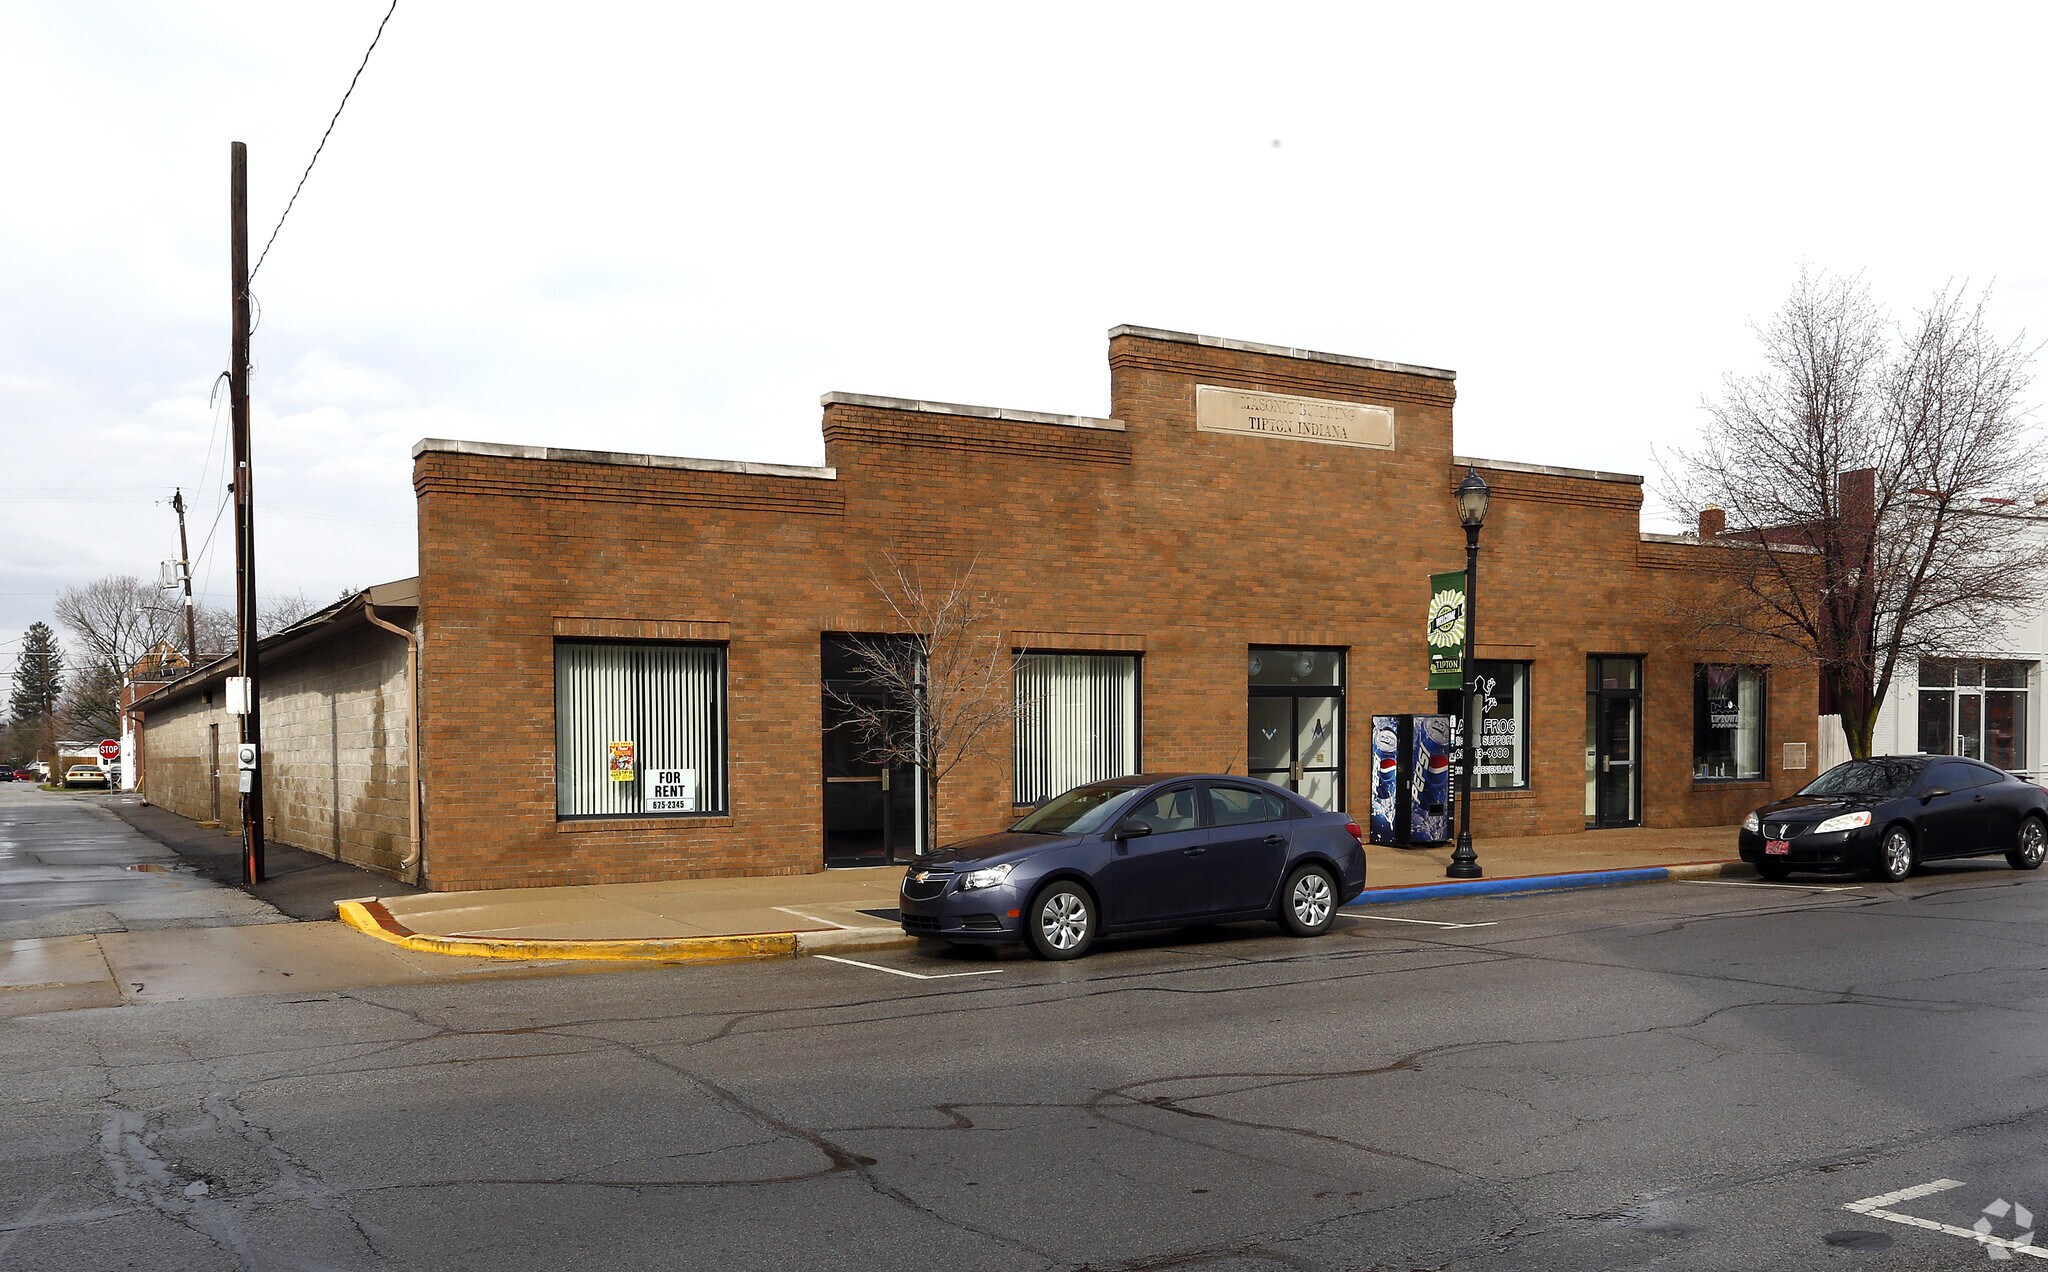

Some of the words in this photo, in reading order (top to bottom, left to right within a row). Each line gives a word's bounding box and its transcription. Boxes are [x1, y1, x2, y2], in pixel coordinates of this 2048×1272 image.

[1241, 396, 1294, 415] MASONIC
[1299, 403, 1355, 421] BUILDING
[1249, 416, 1292, 433] TIPTON
[1298, 421, 1348, 439] INDIANA
[1435, 660, 1459, 669] TIPTON
[1483, 718, 1516, 734] FROG
[1482, 735, 1516, 746] SUPPORT
[100, 745, 118, 754] STOP
[659, 771, 681, 784] FOR
[1411, 741, 1432, 806] PEPSI
[655, 785, 685, 798] RENT
[652, 801, 685, 809] 675-2345
